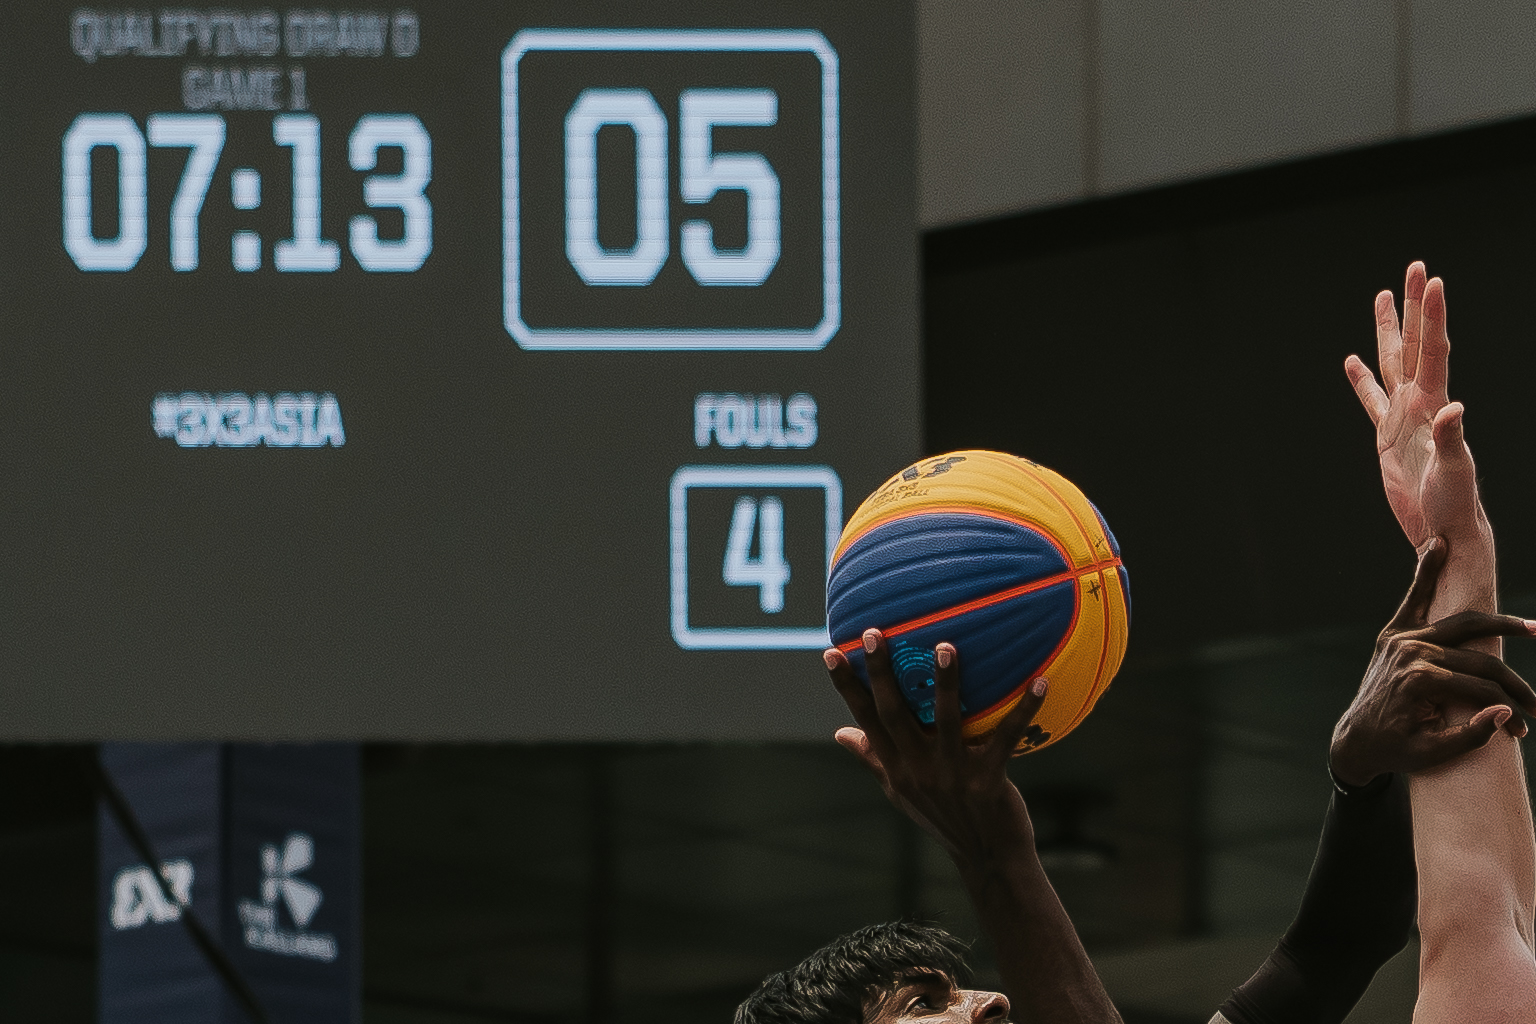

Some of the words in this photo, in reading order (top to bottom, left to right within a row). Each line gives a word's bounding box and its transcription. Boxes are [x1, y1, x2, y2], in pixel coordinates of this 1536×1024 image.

[70, 8, 280, 63] QUALIFYING
[182, 65, 283, 110] GAME
[289, 66, 310, 111] 1
[63, 115, 431, 271] 07:13
[565, 90, 780, 286] 05
[695, 395, 817, 447] FOULS
[723, 498, 790, 613] 4
